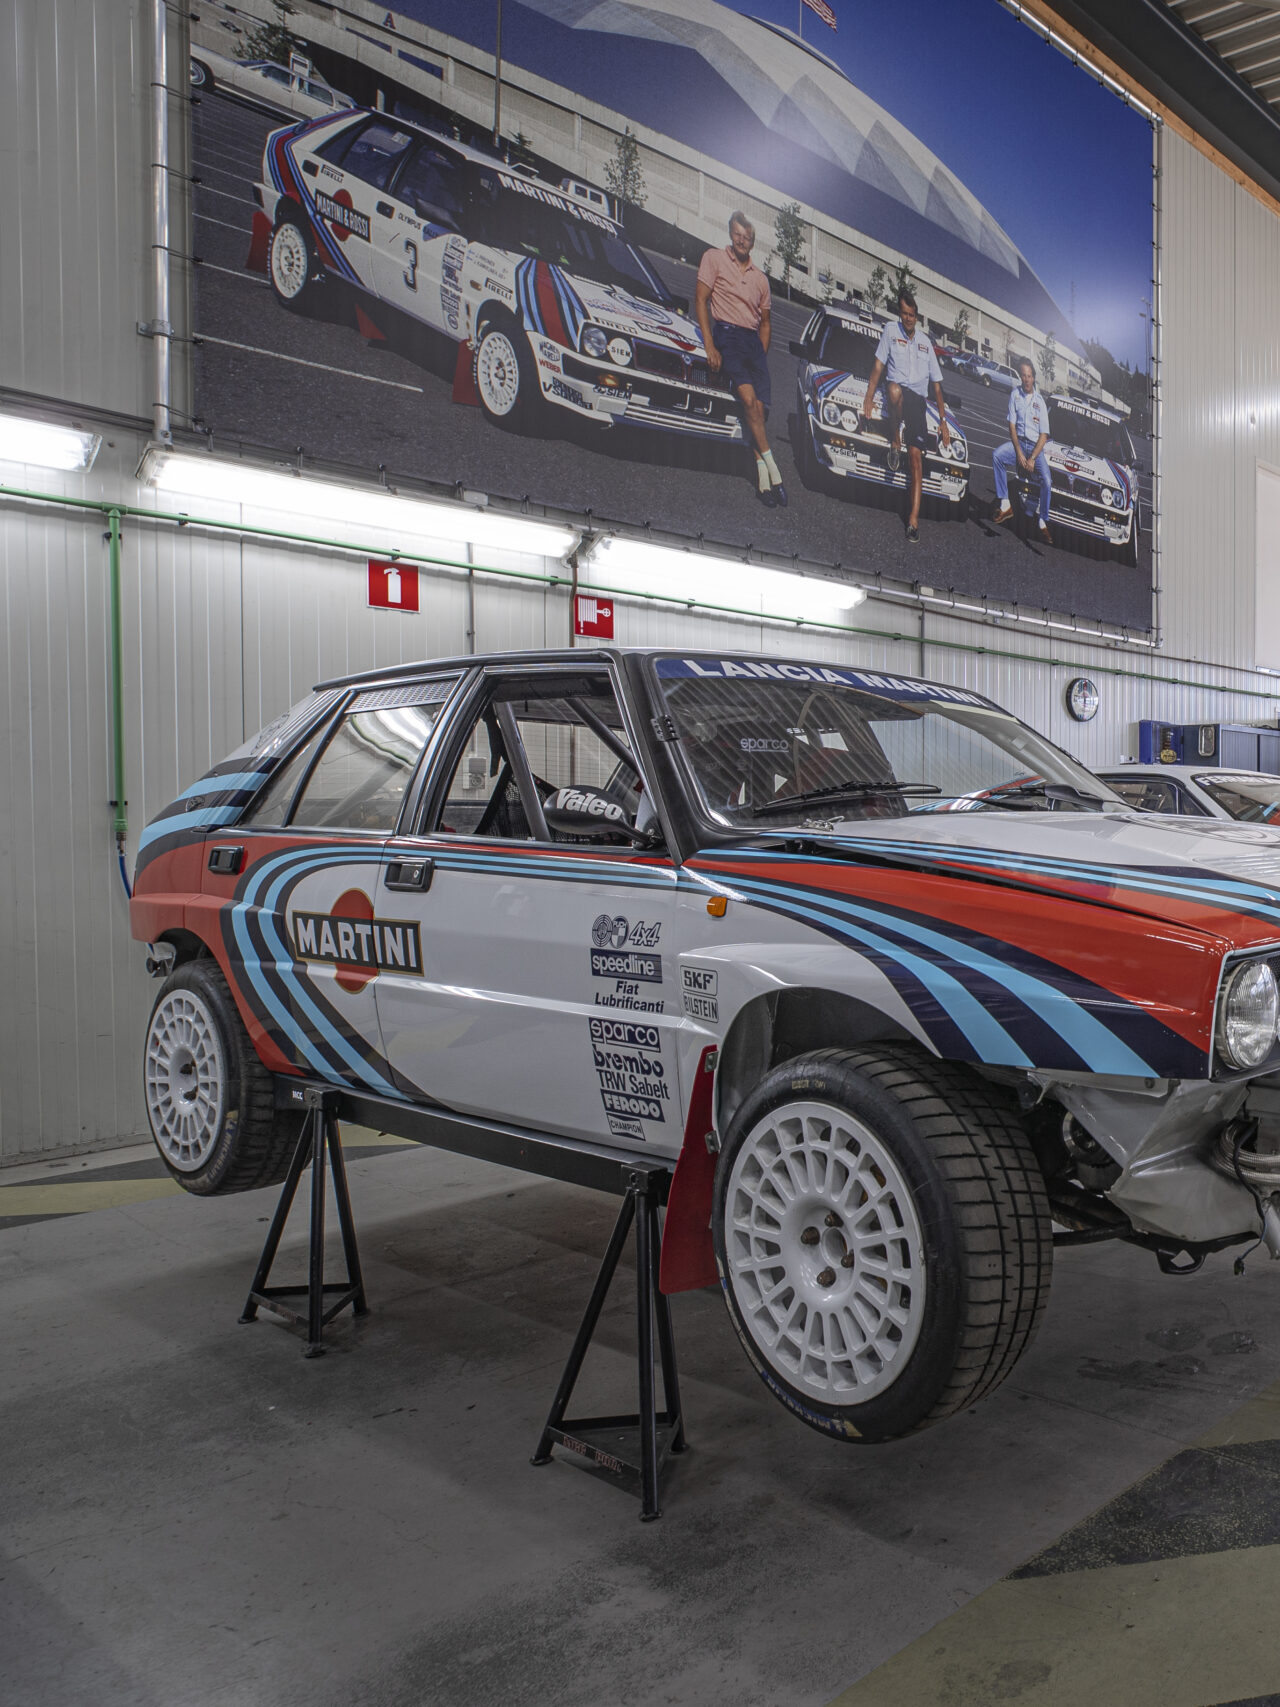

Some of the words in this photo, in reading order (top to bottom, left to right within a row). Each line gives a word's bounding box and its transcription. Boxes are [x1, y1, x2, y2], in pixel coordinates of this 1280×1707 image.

[383, 12, 396, 29] A
[316, 193, 344, 225] MARTINI
[344, 208, 350, 228] &
[350, 211, 369, 239] ROSSI
[498, 172, 567, 212] MARTINI
[567, 201, 581, 220] &
[578, 206, 618, 238] ROSSI
[398, 213, 421, 230] OLYMPUS
[485, 277, 514, 301] PIRELLI
[593, 316, 639, 335] PIRELLI
[841, 320, 881, 340] MARTINI
[611, 346, 632, 357] SIEM
[539, 359, 561, 374] WEBER
[608, 386, 632, 401] SIEM
[1057, 400, 1086, 416] MARTINI
[1085, 410, 1092, 418] &
[1091, 413, 1111, 426] ROSSI
[840, 448, 858, 459] SIEM
[683, 659, 852, 685] LANCIA
[851, 672, 989, 707] MARTINI
[740, 738, 789, 750] sparco
[556, 788, 623, 820] Valeo
[296, 917, 416, 968] MARTINI
[629, 921, 661, 947] 4x4
[592, 954, 655, 976] speedline
[616, 981, 639, 995] Fiat
[684, 970, 713, 990] SKF
[595, 992, 664, 1014] Lubrificanti
[684, 995, 718, 1020] BILSTEIN
[590, 1020, 659, 1046] sparco
[592, 1043, 664, 1078] brembo
[596, 1068, 626, 1092] TRW
[629, 1074, 670, 1100] Sabelt
[603, 1093, 660, 1118] FERODO
[610, 1120, 642, 1133] CHAMPION
